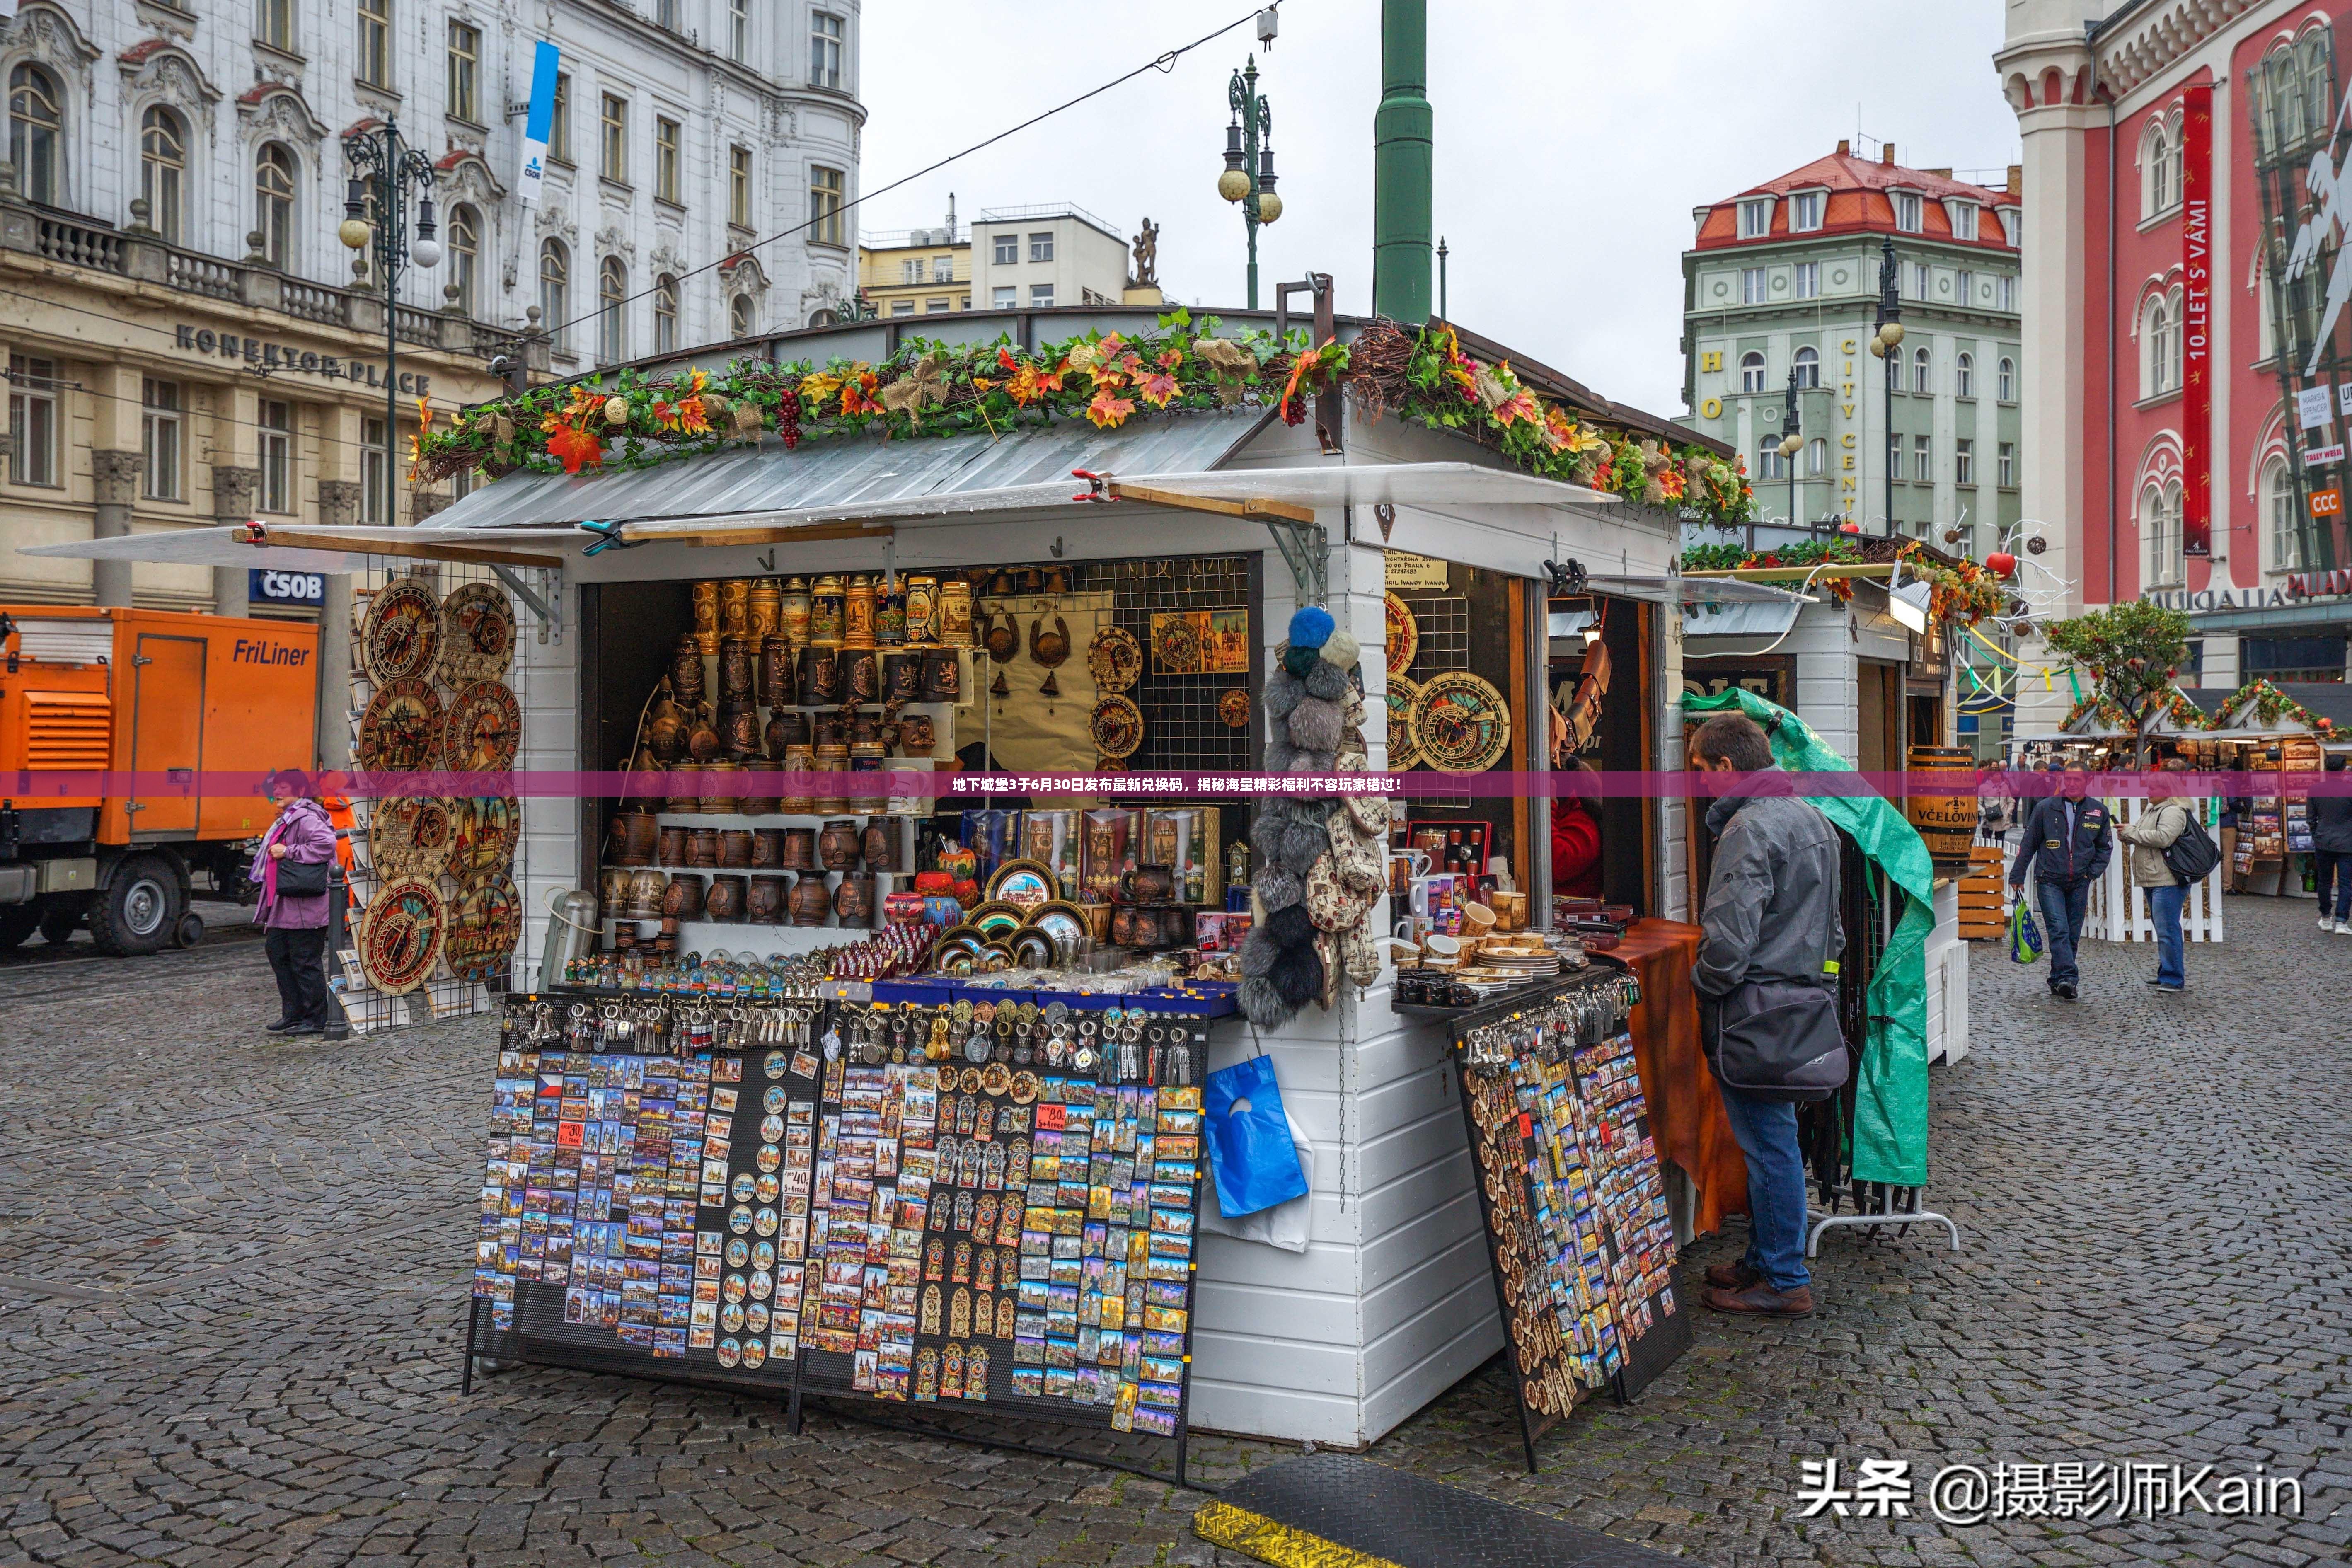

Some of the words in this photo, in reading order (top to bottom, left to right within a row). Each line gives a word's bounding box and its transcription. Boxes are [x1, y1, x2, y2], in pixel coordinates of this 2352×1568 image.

[524, 167, 540, 180] ČSOB
[2185, 200, 2206, 259] VÁMI
[2189, 268, 2206, 278] S
[2189, 288, 2206, 324] LET
[177, 324, 338, 377] KONEKTOR
[350, 361, 430, 396] PLACE
[2189, 335, 2206, 361] 10
[1841, 339, 1856, 419] CITY
[2302, 393, 2321, 405] MARKS
[2303, 404, 2328, 416] SPENCER
[2306, 451, 2323, 462] TALLY
[2313, 493, 2337, 513] CCC
[263, 570, 322, 599] ČSOB
[2287, 568, 2352, 597] PALLAD
[233, 639, 310, 666] FriLiner
[942, 1389, 961, 1397] PRAHA
